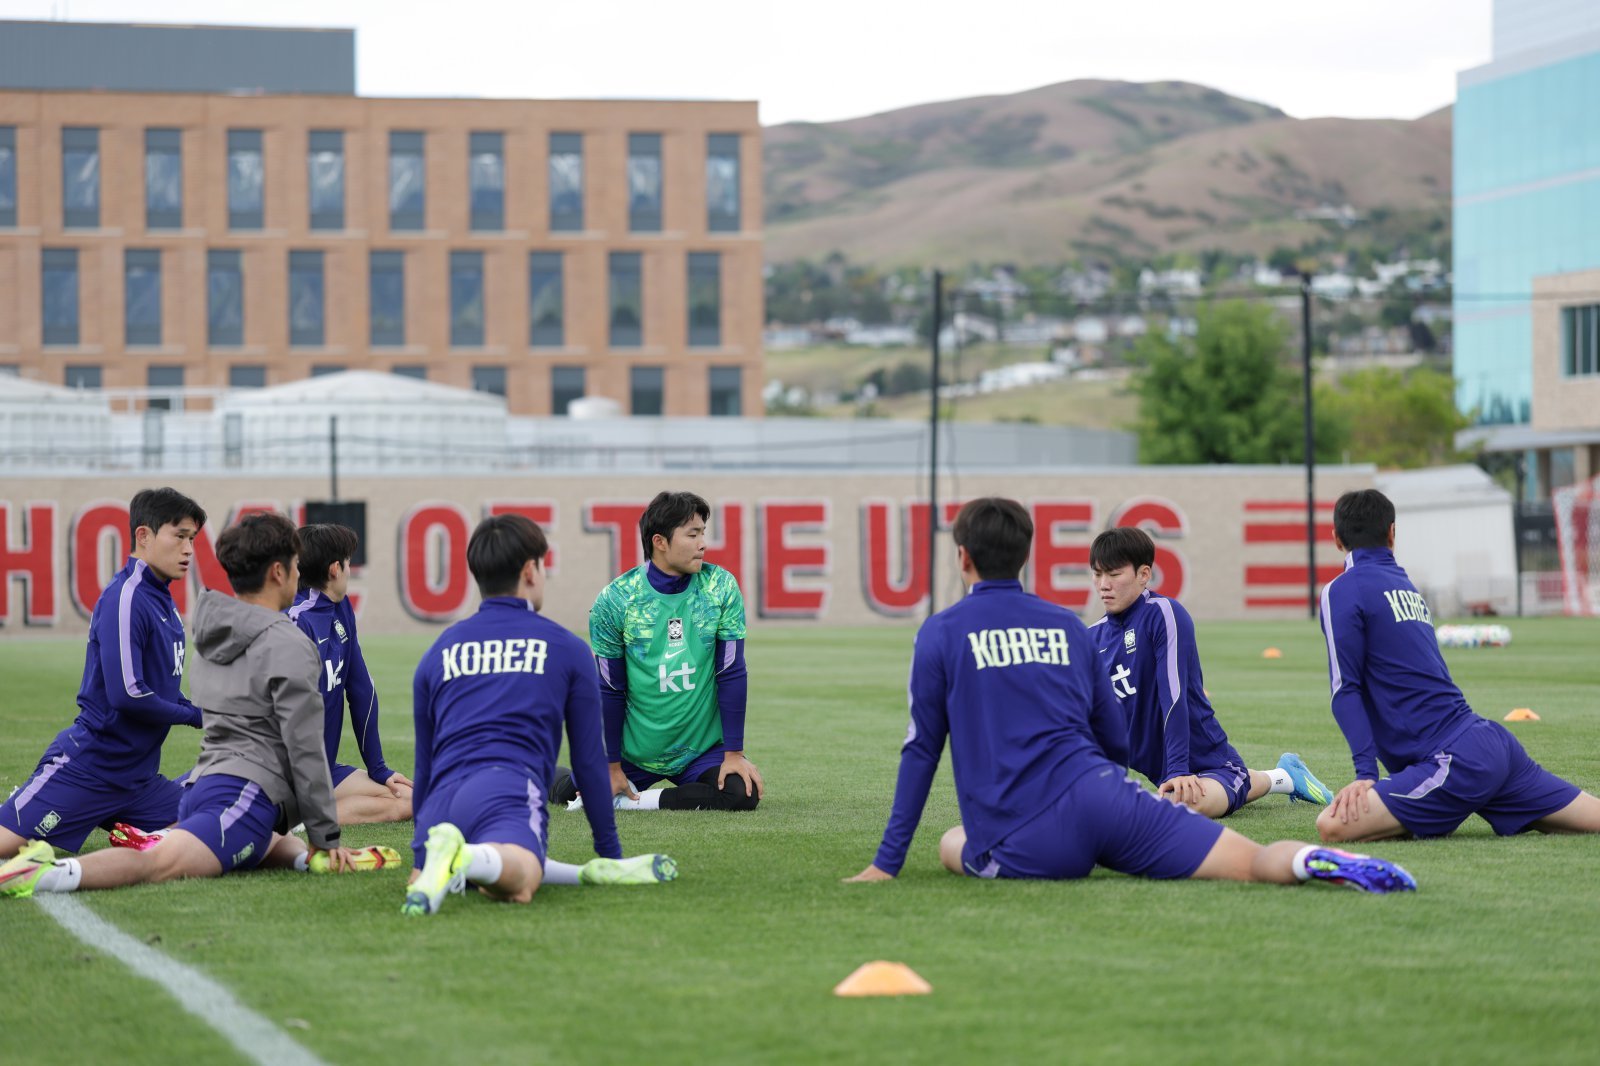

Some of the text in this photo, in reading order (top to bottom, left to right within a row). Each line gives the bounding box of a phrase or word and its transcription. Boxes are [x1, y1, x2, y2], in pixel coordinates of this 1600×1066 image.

[441, 638, 548, 682] KOREA
[967, 627, 1071, 670] KOREA
[658, 661, 697, 693] kt
